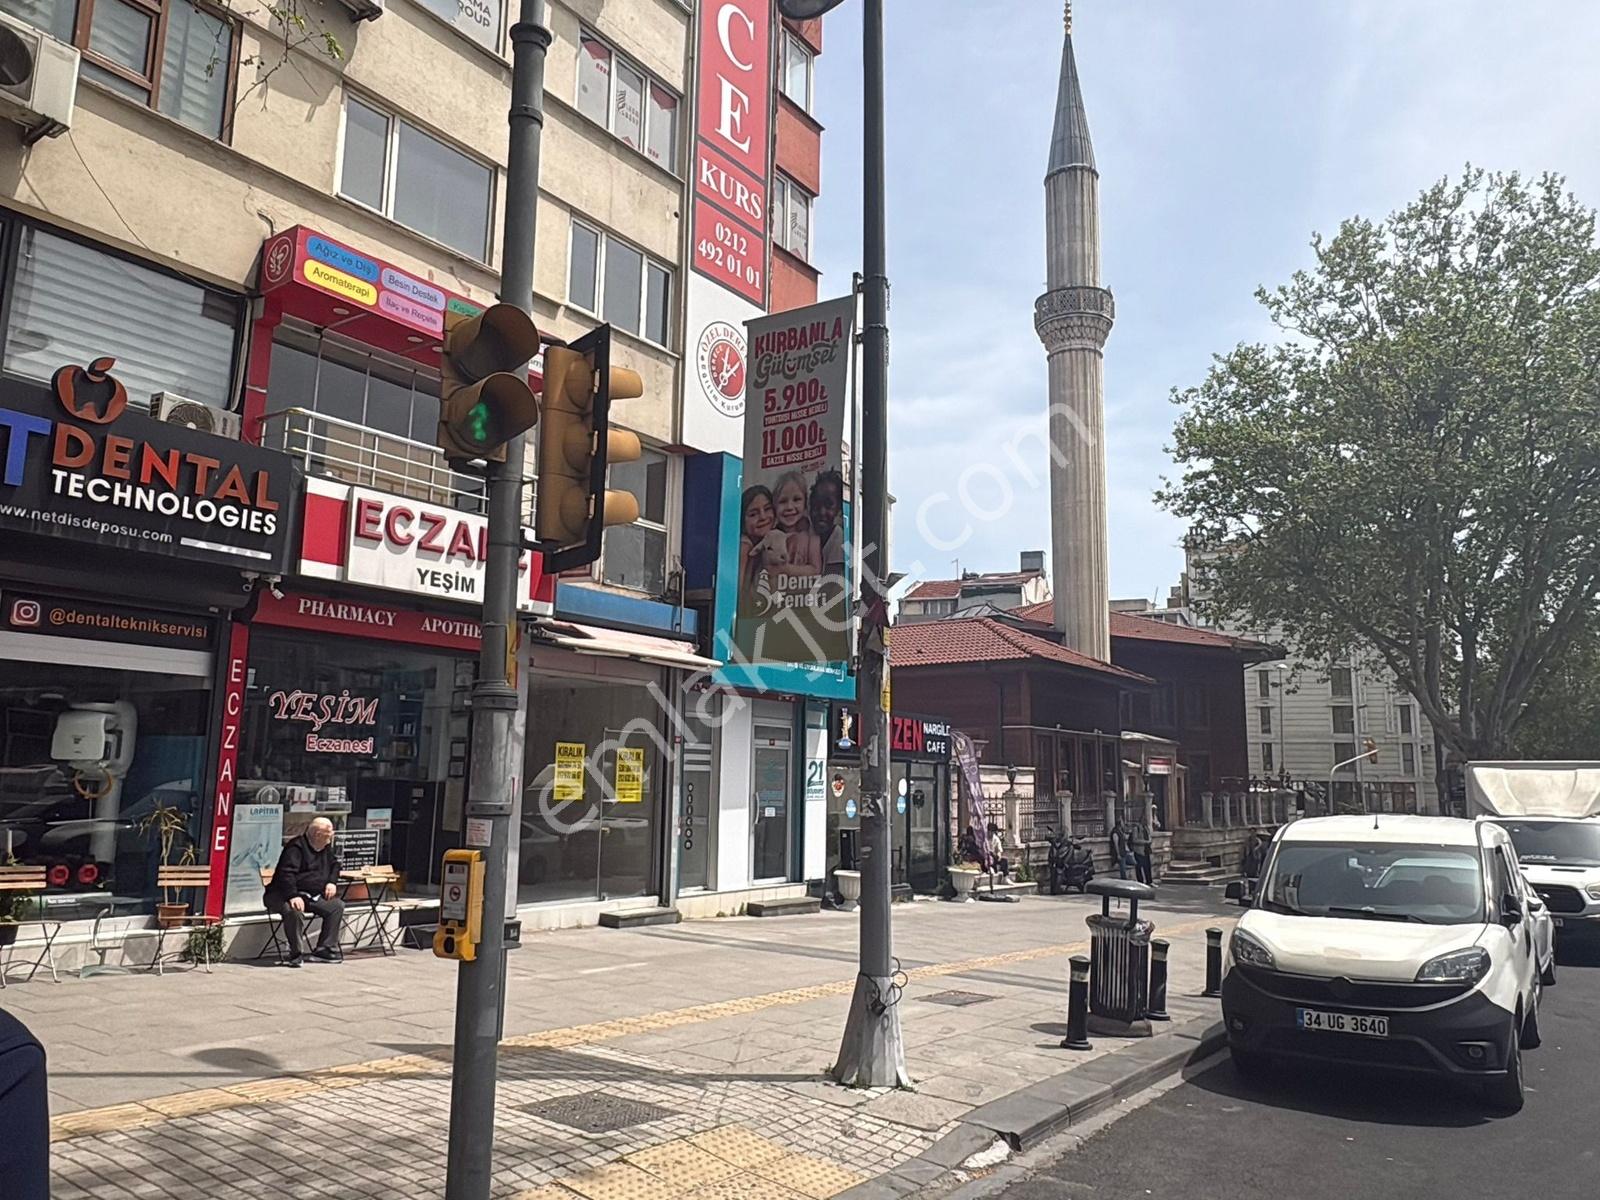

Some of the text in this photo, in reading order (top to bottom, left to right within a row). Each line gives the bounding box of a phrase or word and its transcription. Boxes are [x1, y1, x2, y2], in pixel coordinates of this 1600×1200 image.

[700, 157, 762, 219] KURS
[715, 222, 747, 256] 0212
[315, 242, 372, 275] Ağız ve Diş
[698, 239, 760, 289] 492 01 01
[313, 267, 370, 298] Aromaterapi
[388, 274, 438, 304] Besin Destek
[754, 316, 842, 359] KURBANLA
[52, 422, 279, 511] DENTAL
[52, 469, 277, 535] TECHNOLOGIES
[355, 497, 528, 572] ECZA
[416, 567, 475, 594] YEŞİM
[50, 608, 207, 639] @dentalteknikservisi
[298, 598, 397, 627] PHARMACY
[421, 616, 482, 641] APOTHE
[269, 690, 379, 731] YEŞİM
[214, 659, 242, 851] ECZANE
[306, 733, 374, 754] Eczanesi
[926, 740, 946, 754] CAFE
[1305, 1012, 1386, 1035] 34 UG 3640
